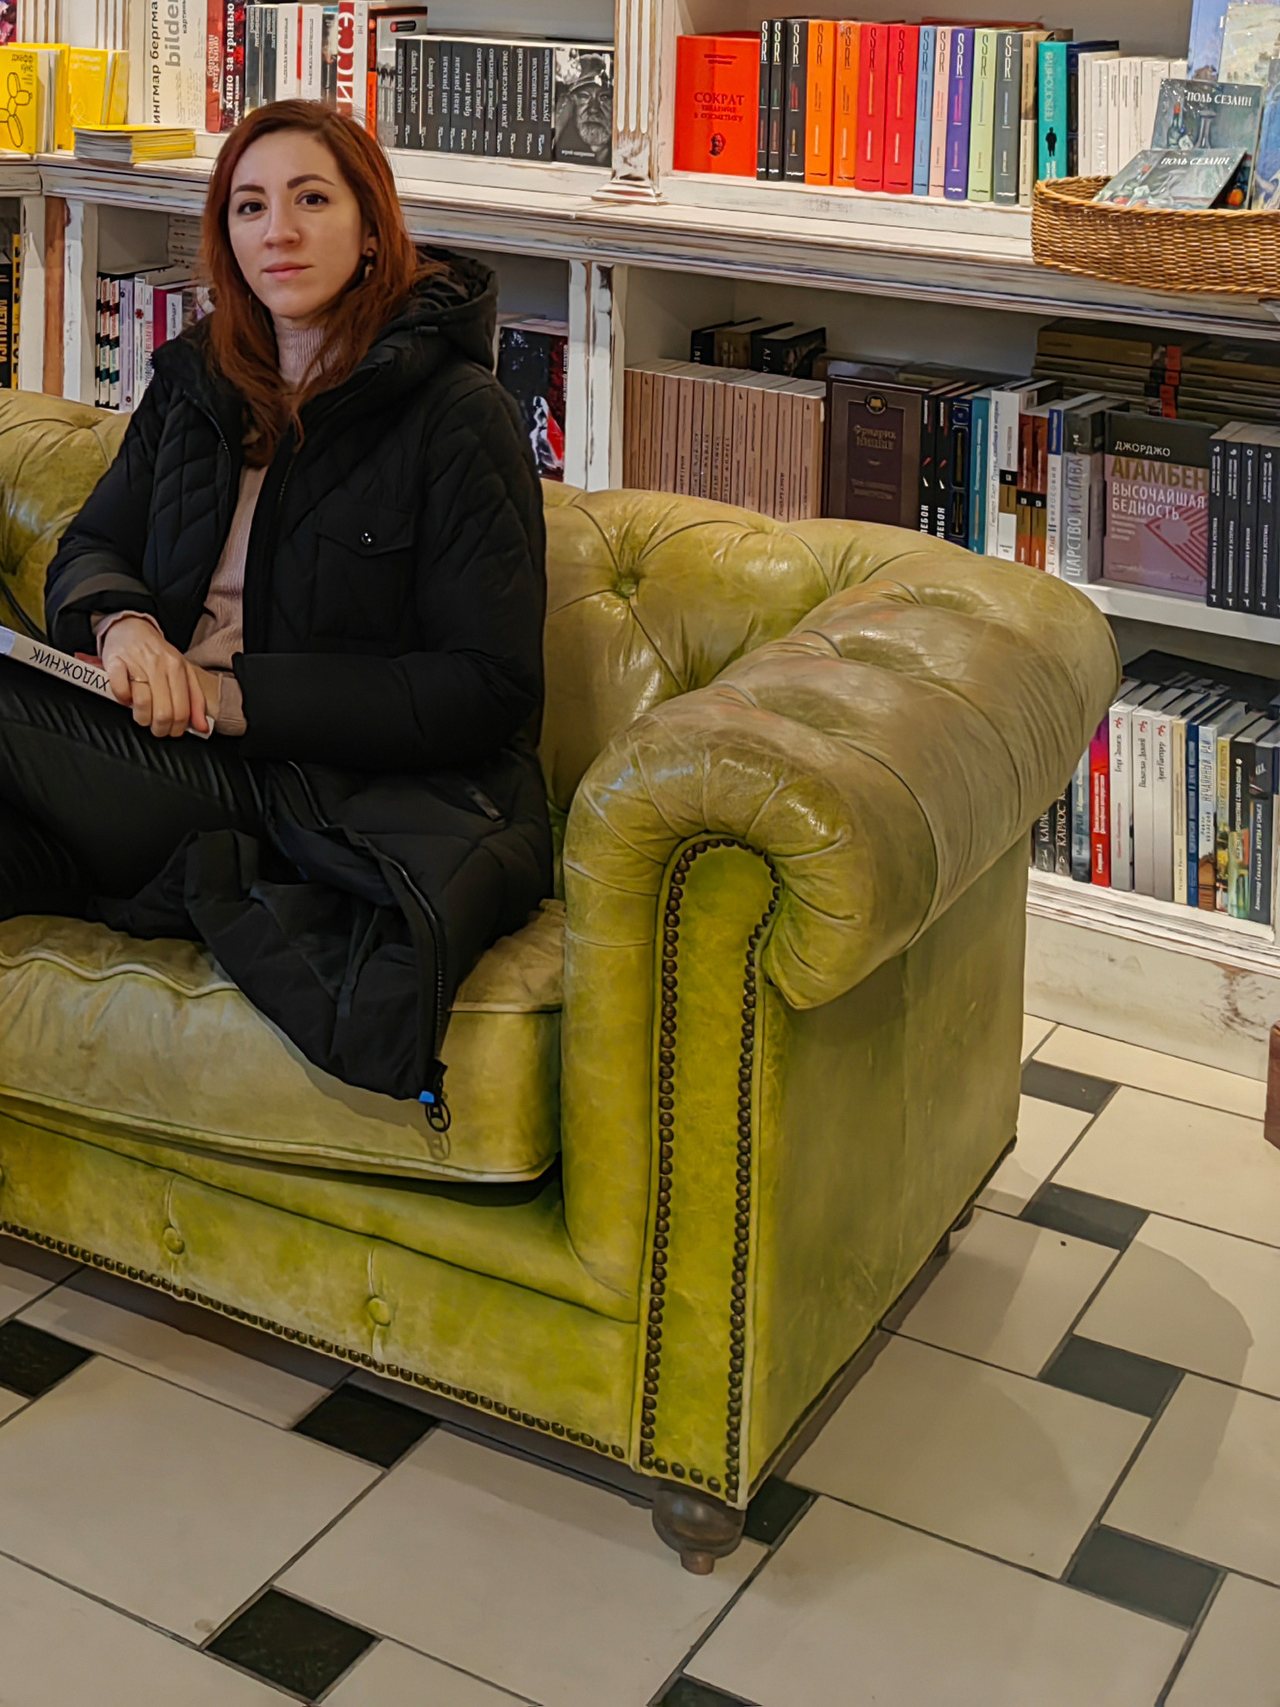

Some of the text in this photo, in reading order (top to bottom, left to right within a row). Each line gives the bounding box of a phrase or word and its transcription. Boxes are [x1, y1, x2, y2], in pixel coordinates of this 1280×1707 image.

[224, 3, 236, 109] кино за гранью
[442, 56, 450, 90] рикман
[454, 56, 462, 91] рикман
[151, 64, 162, 124] ингмар
[463, 95, 471, 117] брэд
[516, 94, 524, 121] роман
[543, 93, 551, 122] рустам
[693, 91, 745, 107] СОКРАТ
[1187, 90, 1252, 107] ПОЛЬ СЕЗАНН
[1160, 156, 1230, 166] ПОЛЬ СЕЗАНН
[1114, 440, 1171, 457] ДЖОРДЖО
[1111, 456, 1209, 492] АГАМБЕН
[1112, 481, 1206, 510] ВЫСОЧАЙШАЯ
[1112, 497, 1180, 522] БЕДНОСТЬ
[1067, 458, 1083, 577] ЦАРСТВО И СЛАВА
[29, 646, 110, 692] ХУДОЖНИК
[1056, 804, 1067, 847] КАРЛОС
